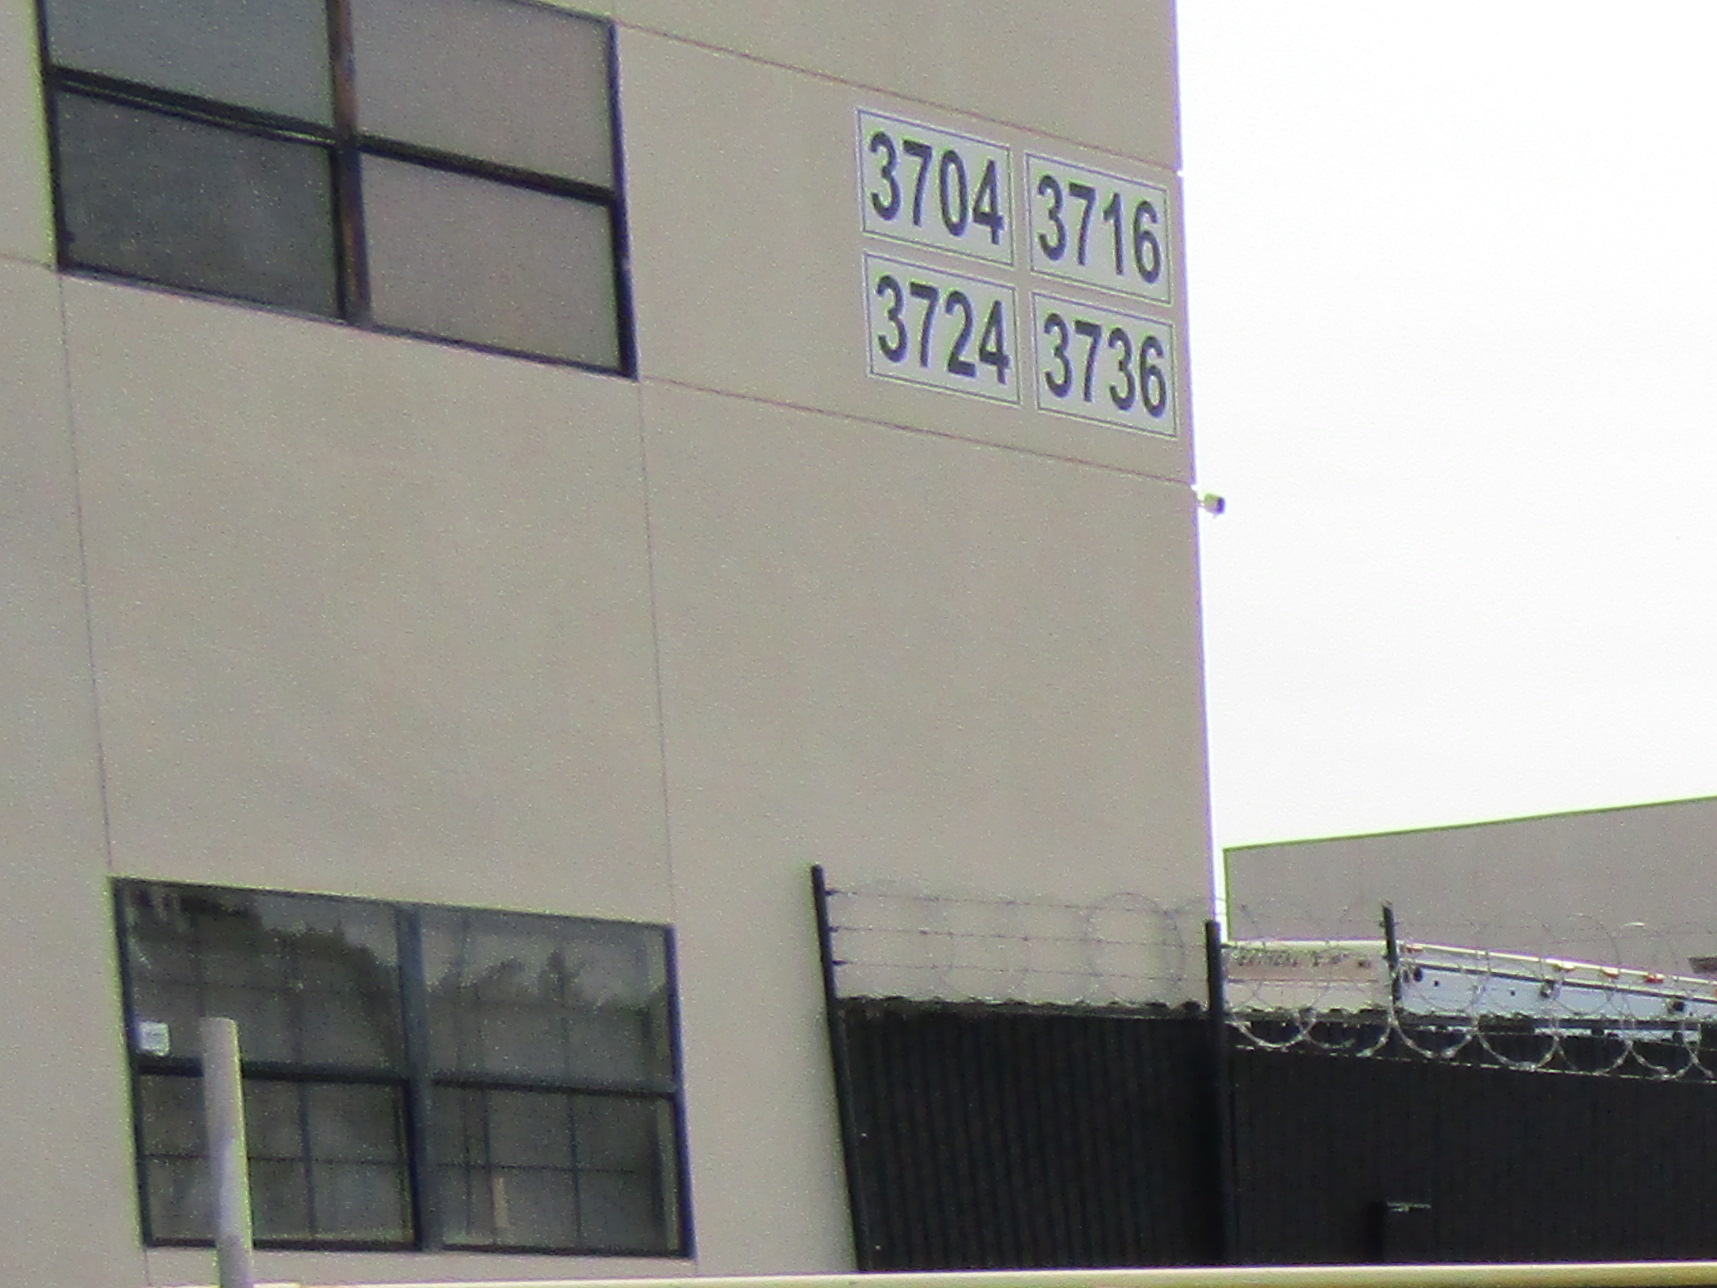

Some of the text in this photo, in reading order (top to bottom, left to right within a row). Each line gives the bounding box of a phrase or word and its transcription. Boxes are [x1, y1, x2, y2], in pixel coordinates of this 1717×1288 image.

[869, 131, 1006, 246] 3704
[1037, 173, 1162, 285] 3716
[876, 274, 1012, 385] 3724
[1043, 312, 1168, 419] 3736
